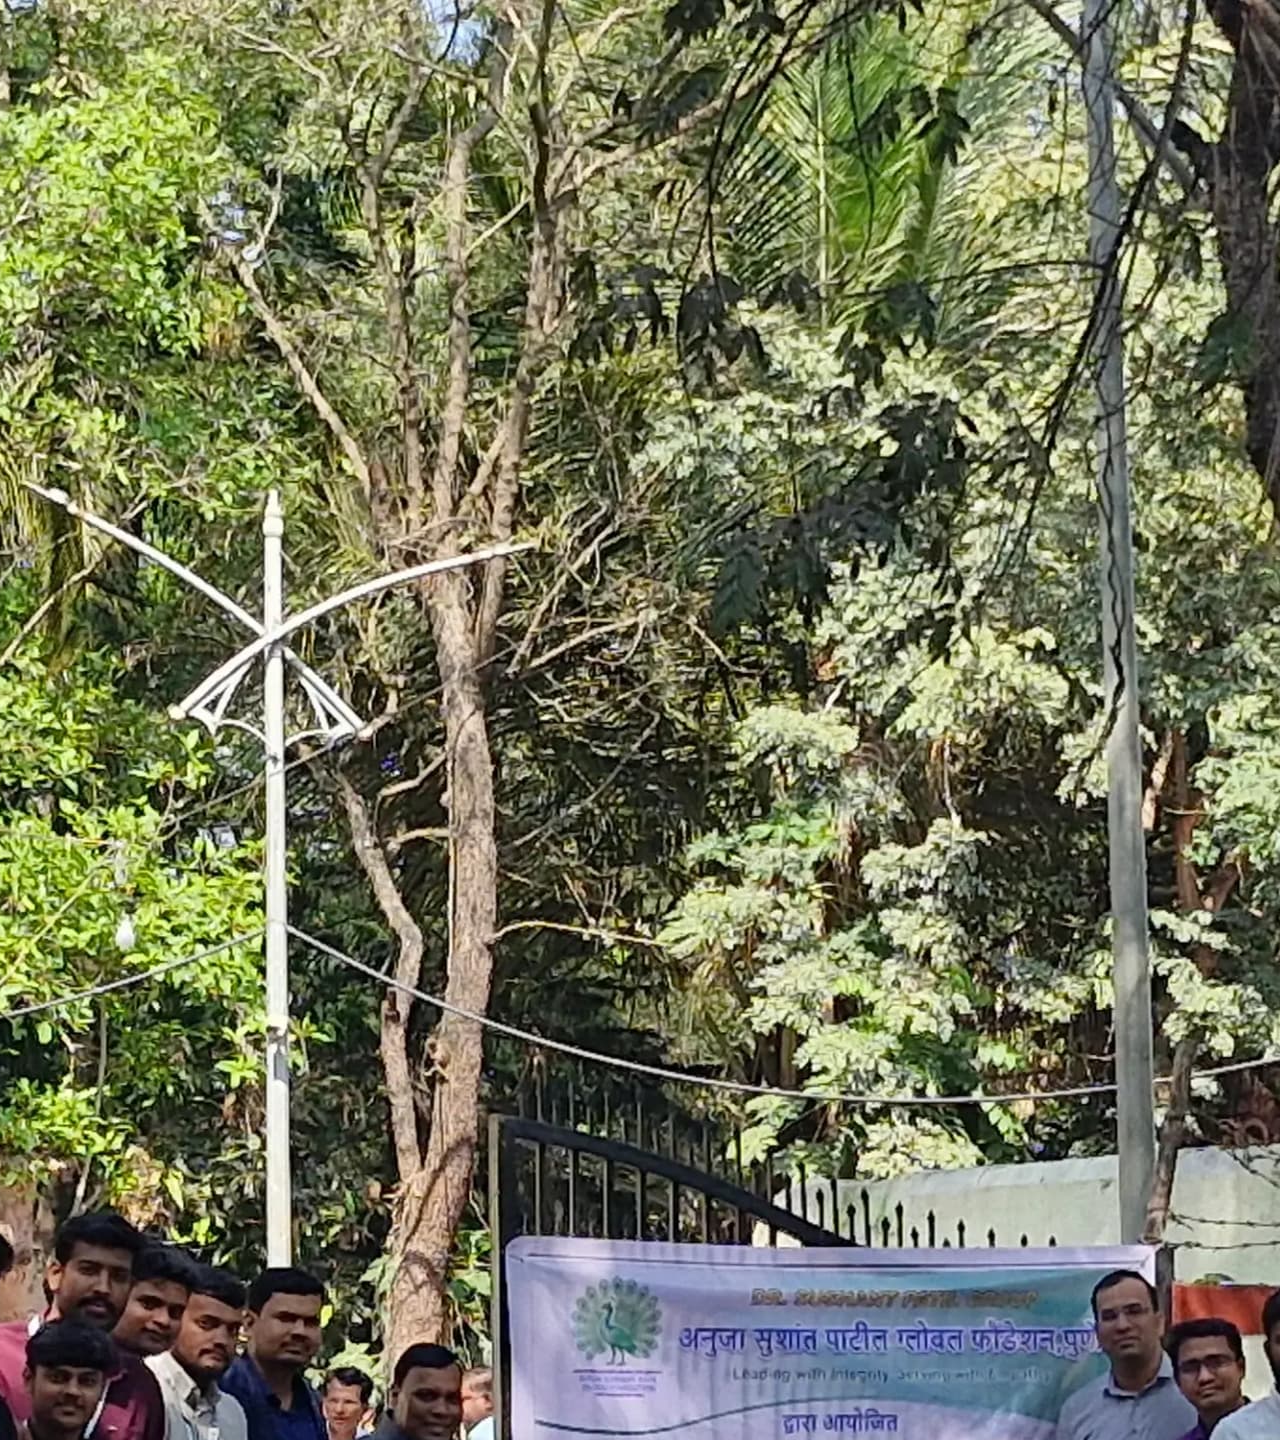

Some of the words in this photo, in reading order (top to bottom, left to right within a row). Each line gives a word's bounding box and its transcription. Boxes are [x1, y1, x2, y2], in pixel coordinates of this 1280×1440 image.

[679, 1326, 746, 1358] अनुजा
[782, 1413, 818, 1434] द्वारा
[823, 1407, 898, 1434] आयोजित
